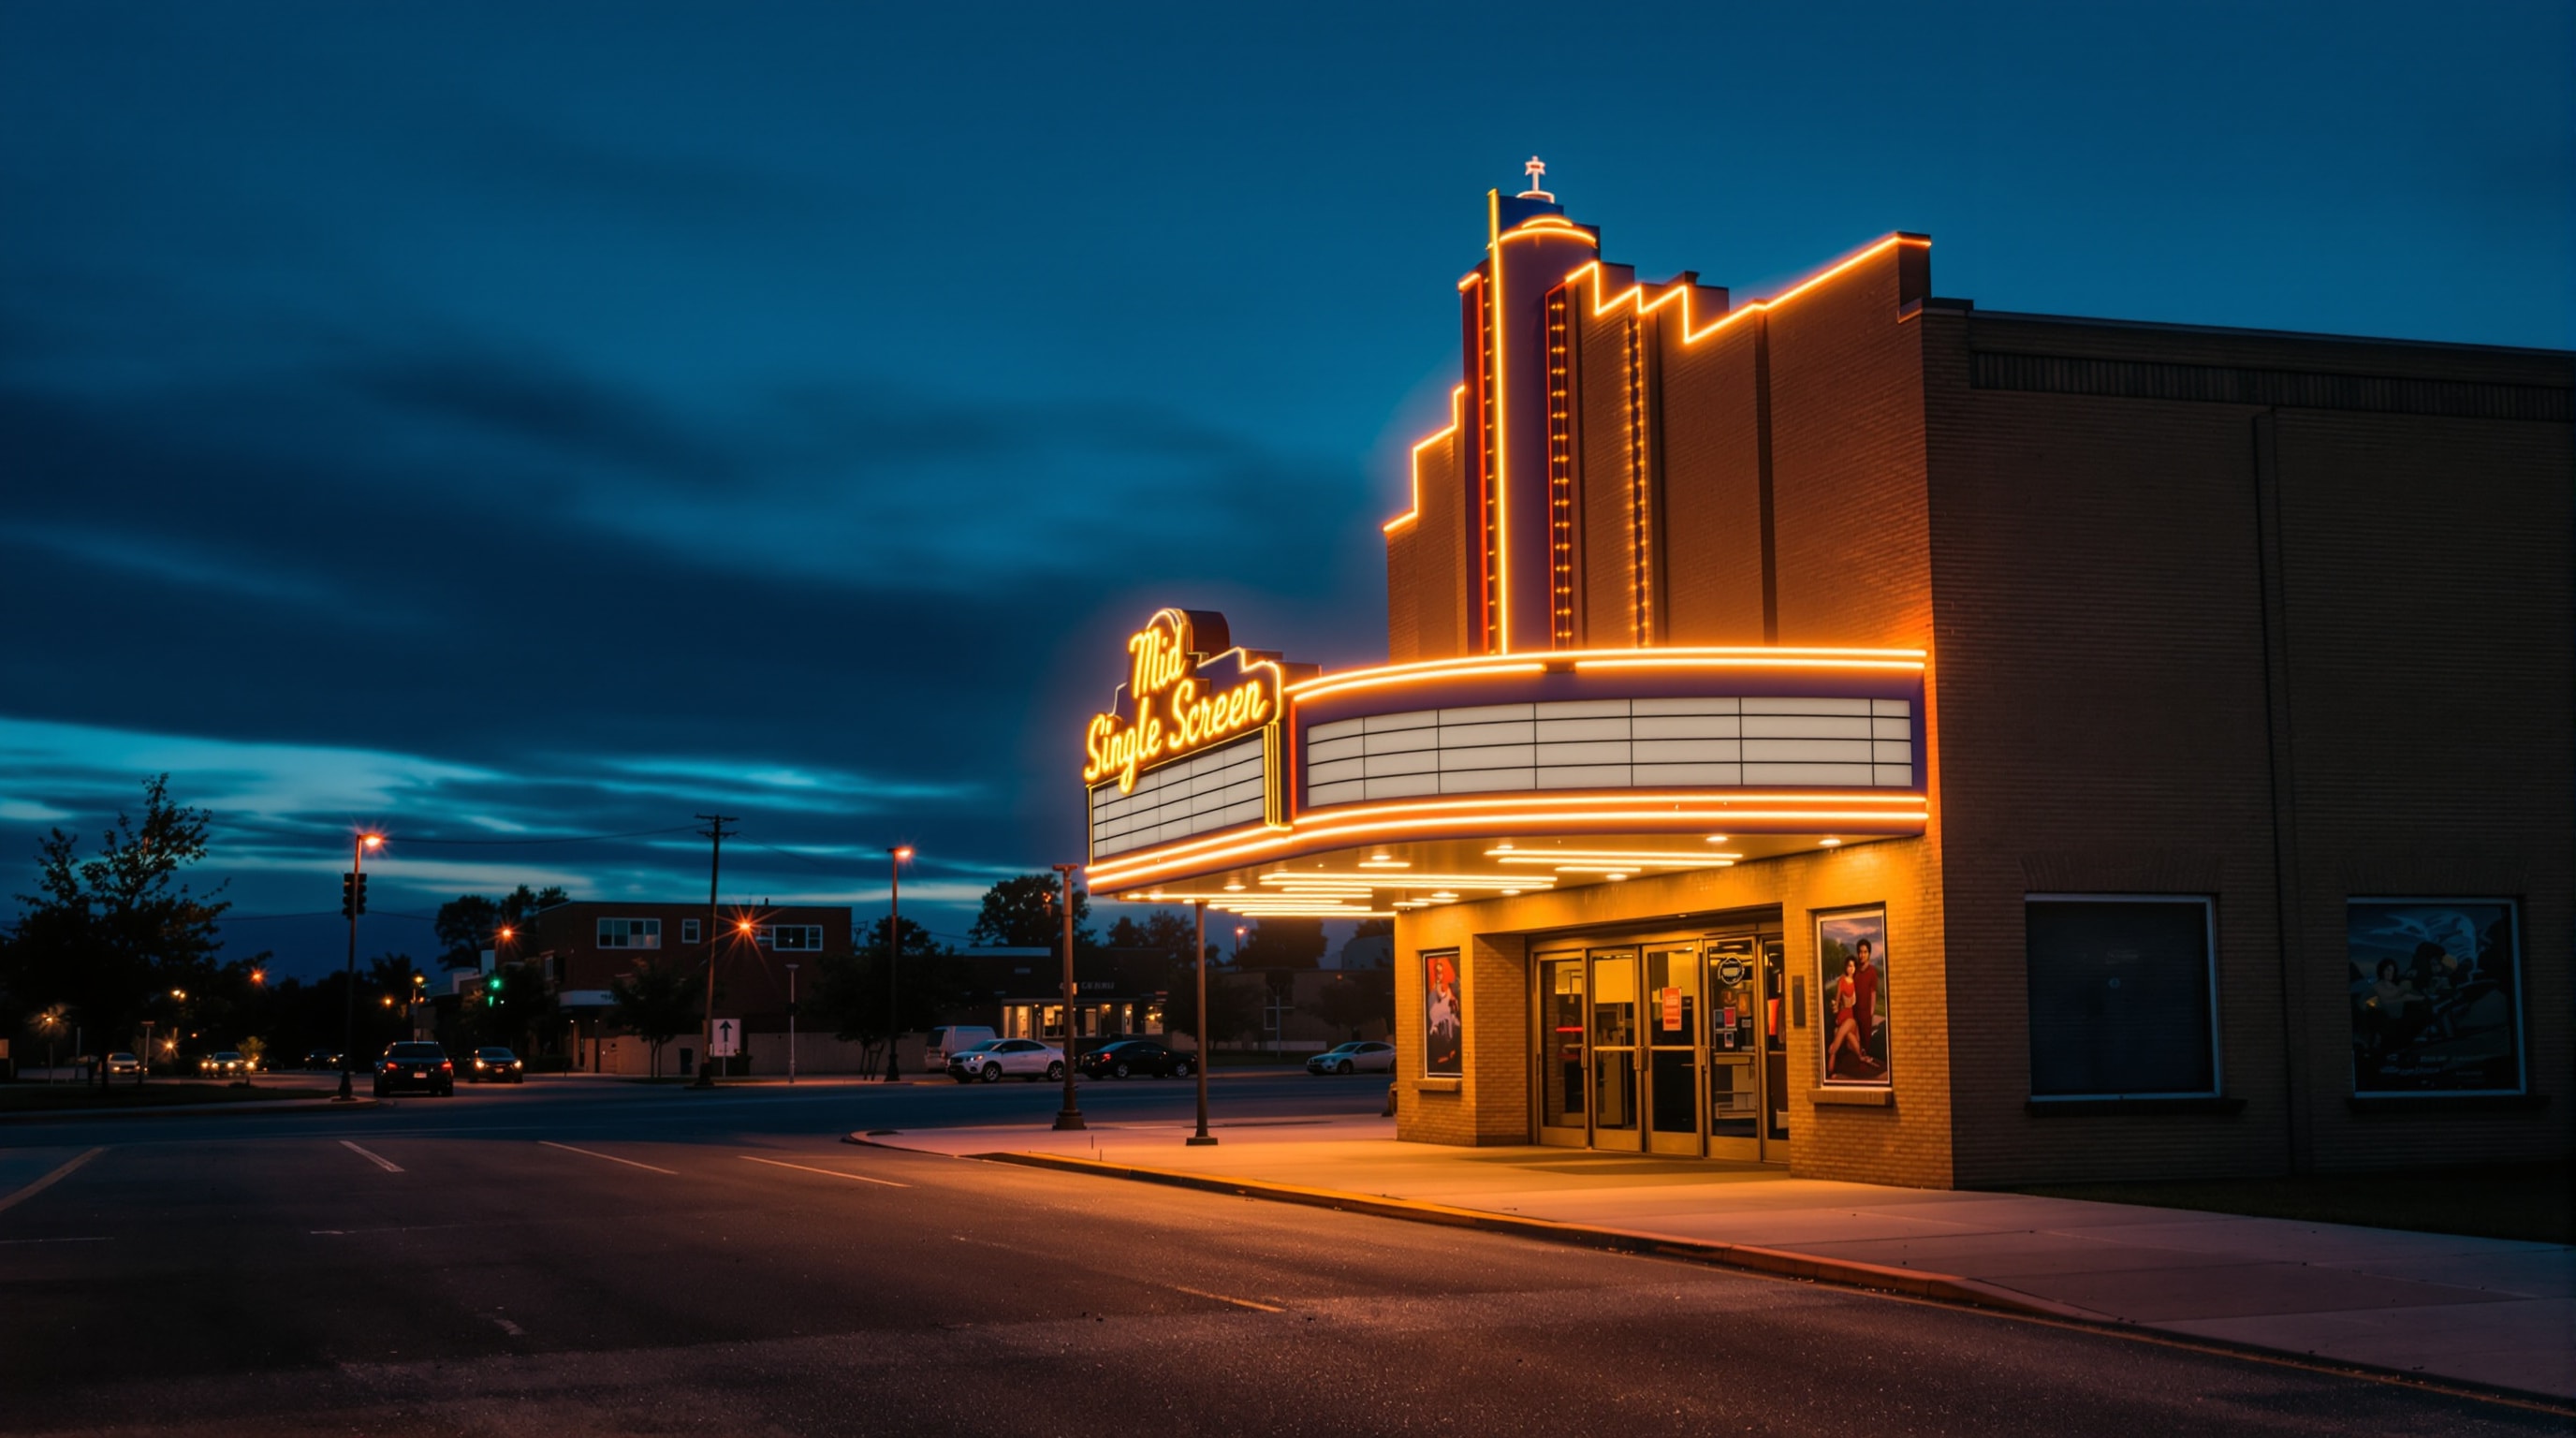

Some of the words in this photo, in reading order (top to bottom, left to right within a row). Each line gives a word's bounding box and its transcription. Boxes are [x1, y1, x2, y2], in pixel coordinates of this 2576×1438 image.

[1129, 624, 1188, 698] Mid
[1084, 697, 1163, 794] Single
[1168, 679, 1269, 749] Screen
